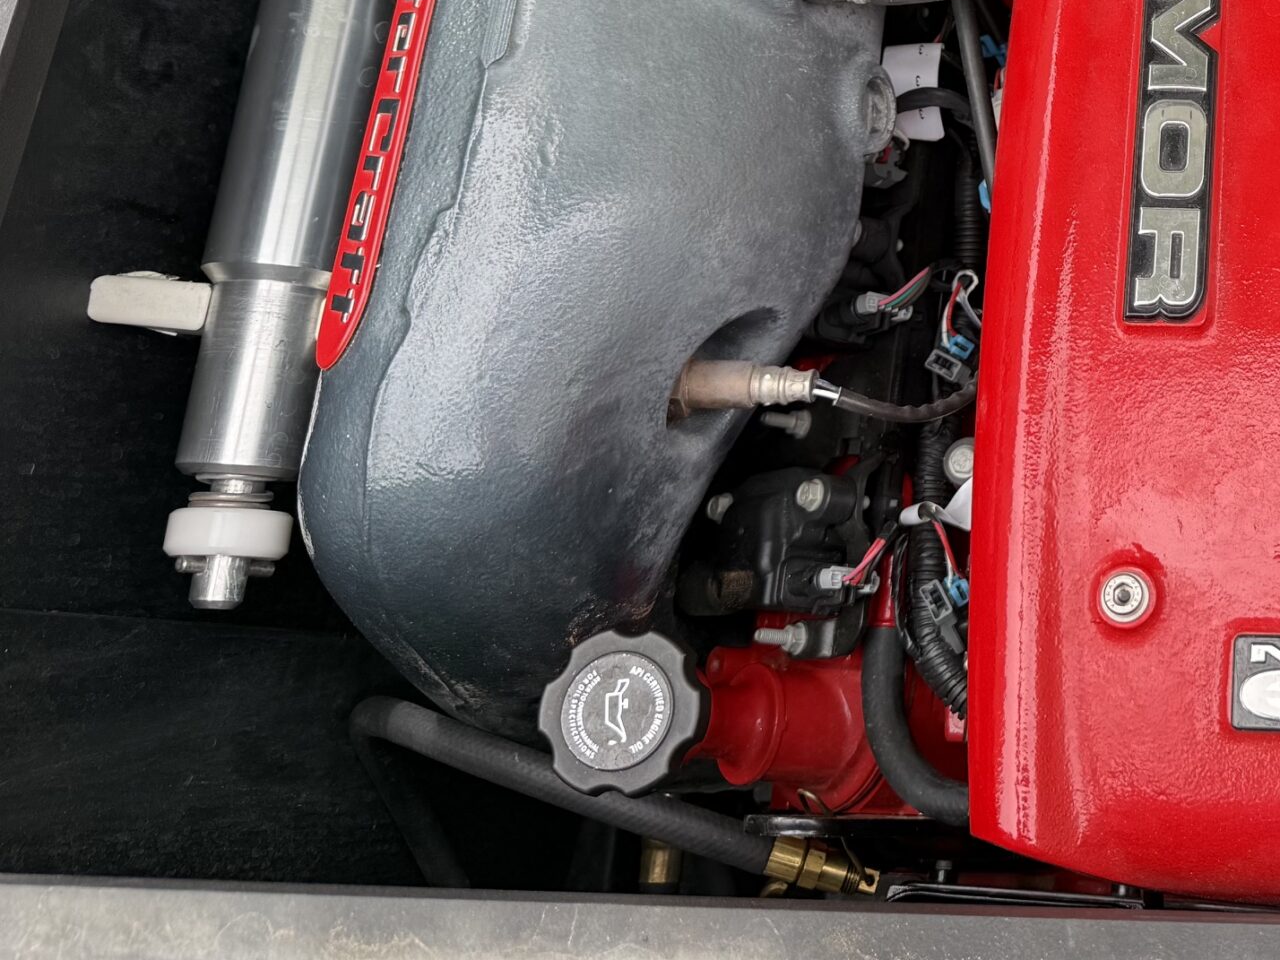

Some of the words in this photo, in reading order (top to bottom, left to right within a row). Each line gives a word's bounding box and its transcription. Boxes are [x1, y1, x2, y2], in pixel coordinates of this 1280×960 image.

[583, 669, 597, 685] FOR
[629, 665, 645, 677] API
[573, 683, 585, 698] OIL
[643, 672, 664, 712] CERTIFIED
[568, 698, 595, 759] SPECIFICATIONS
[641, 713, 663, 744] ENGINE
[629, 741, 644, 754] OIL
